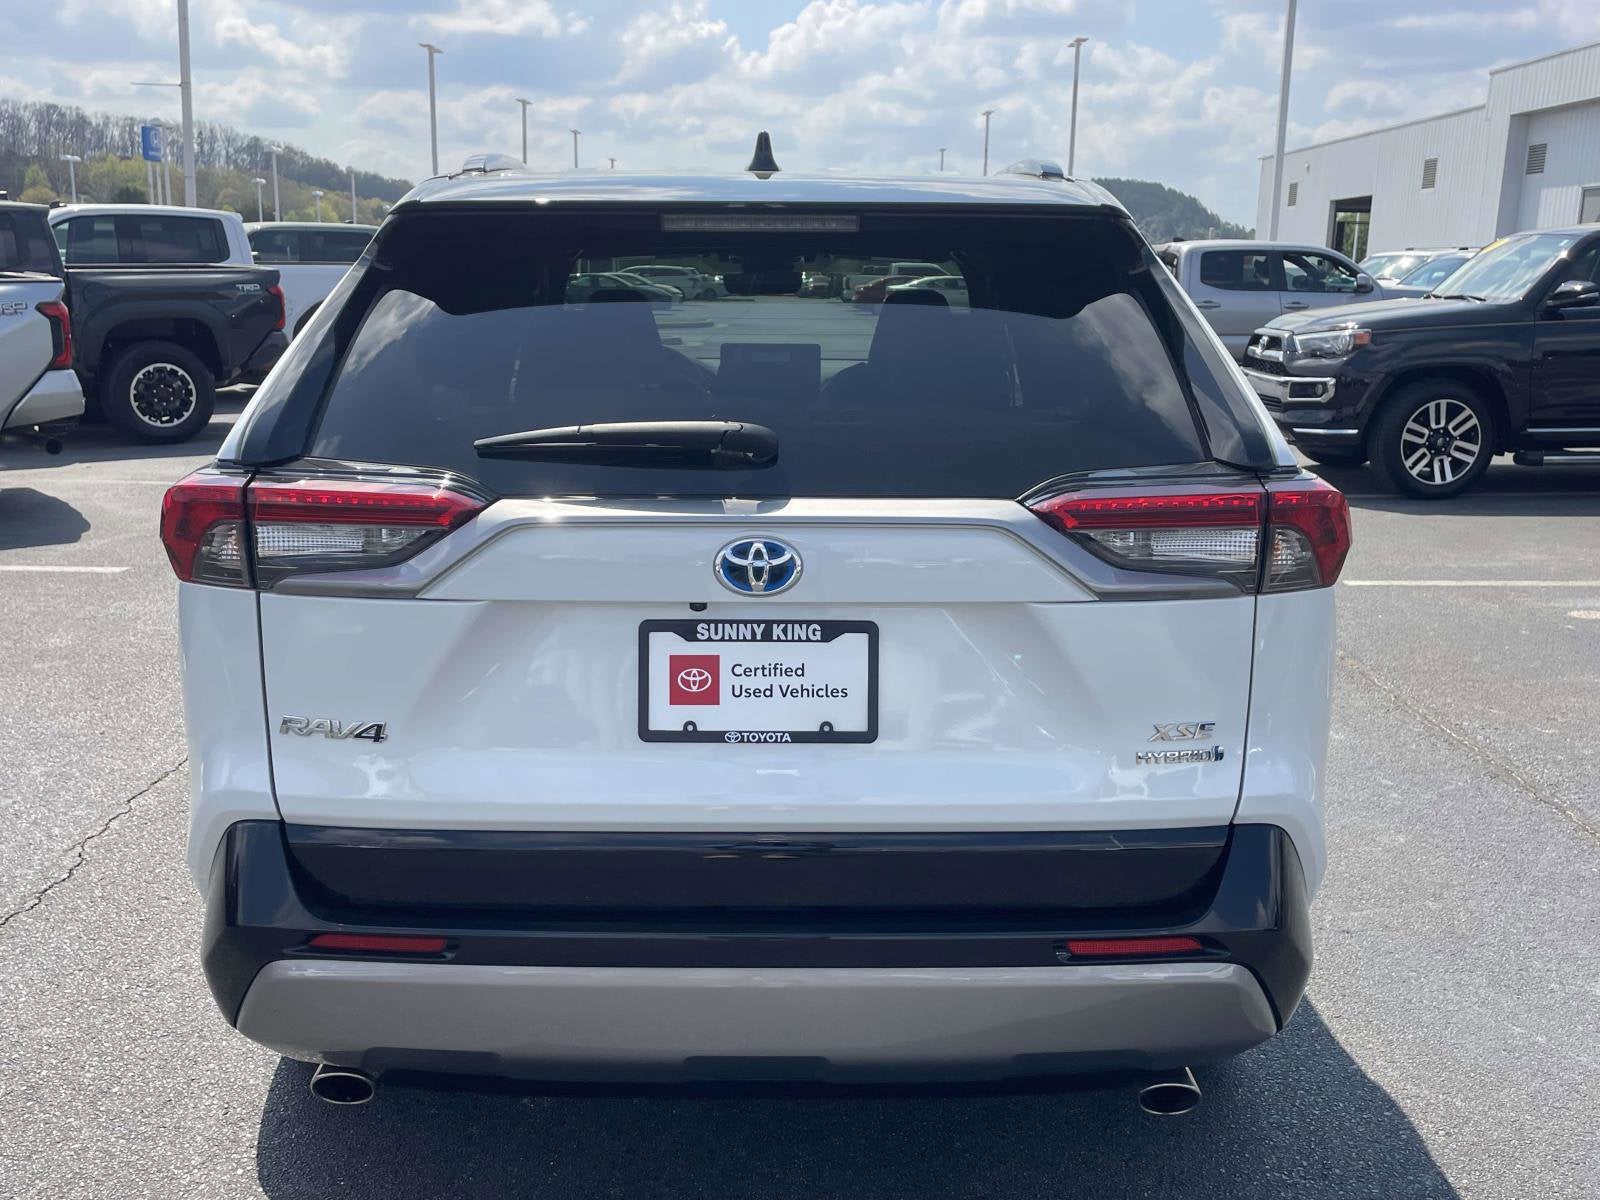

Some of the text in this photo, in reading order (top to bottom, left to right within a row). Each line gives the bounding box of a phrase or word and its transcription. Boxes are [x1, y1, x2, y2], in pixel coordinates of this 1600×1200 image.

[696, 623, 822, 641] SUNNY KING
[731, 663, 806, 678] Certified
[731, 684, 848, 699] Used Vehicles
[280, 714, 388, 743] RAV4
[1147, 721, 1216, 742] XSE
[742, 731, 792, 743] TOYOTA
